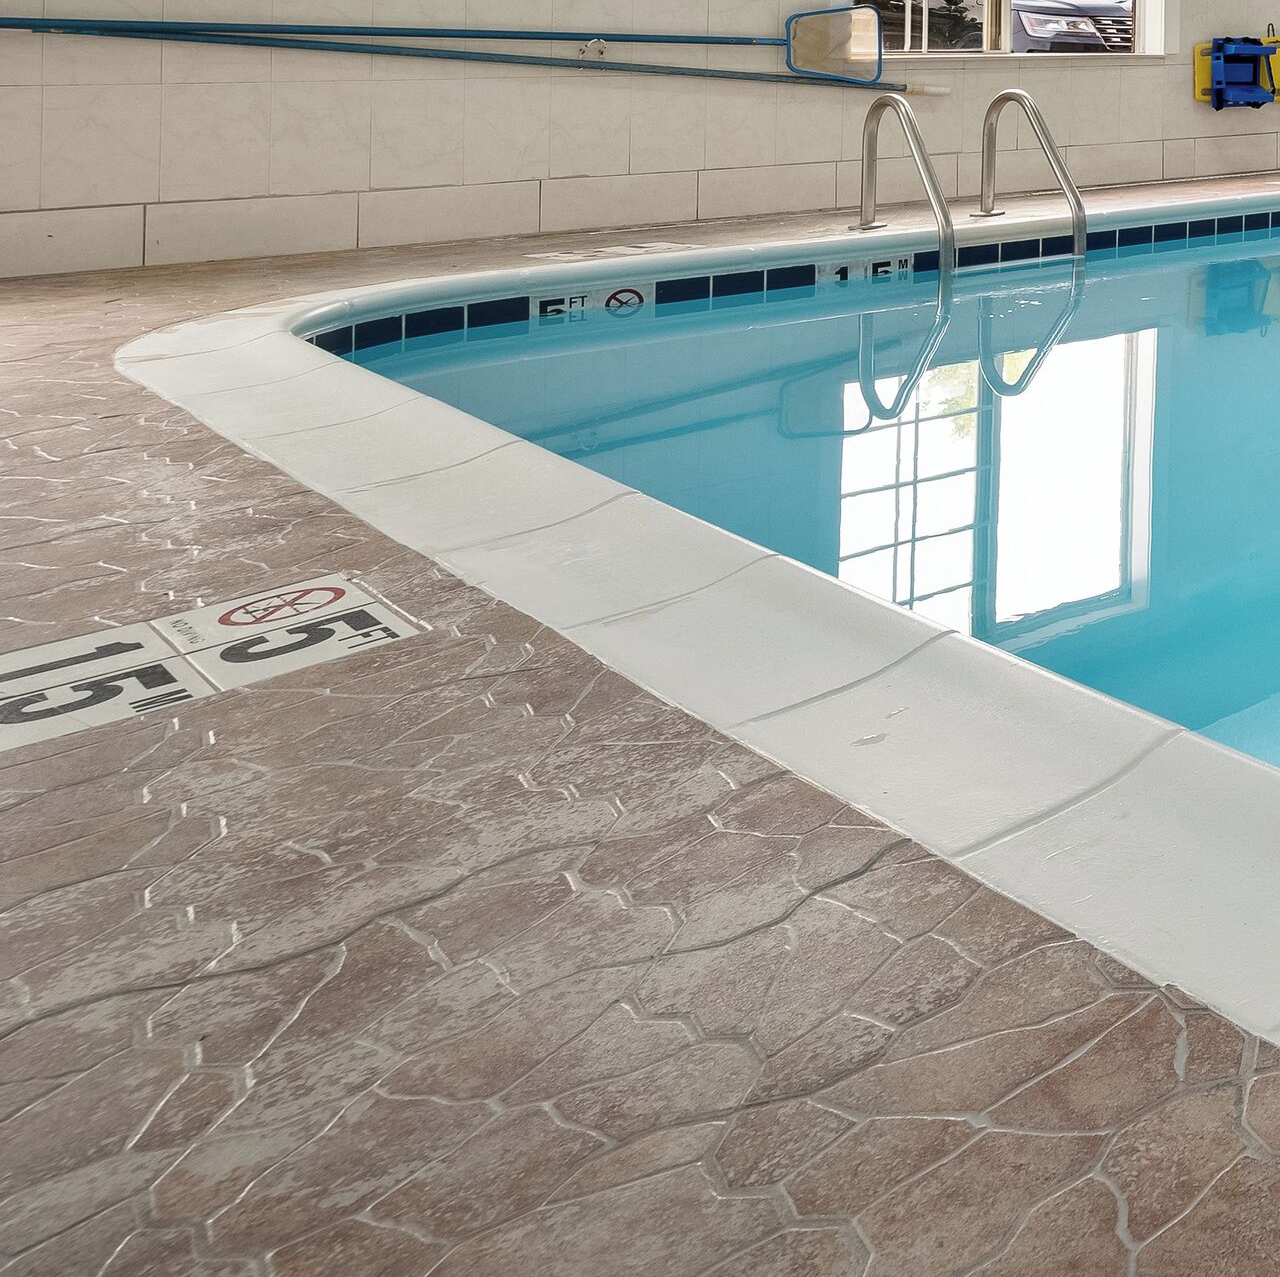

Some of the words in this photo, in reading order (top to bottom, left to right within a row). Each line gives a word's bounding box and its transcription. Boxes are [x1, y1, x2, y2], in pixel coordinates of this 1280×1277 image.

[569, 295, 588, 309] FT
[219, 608, 383, 663] 5
[338, 625, 401, 650] FT
[129, 688, 194, 713] M
